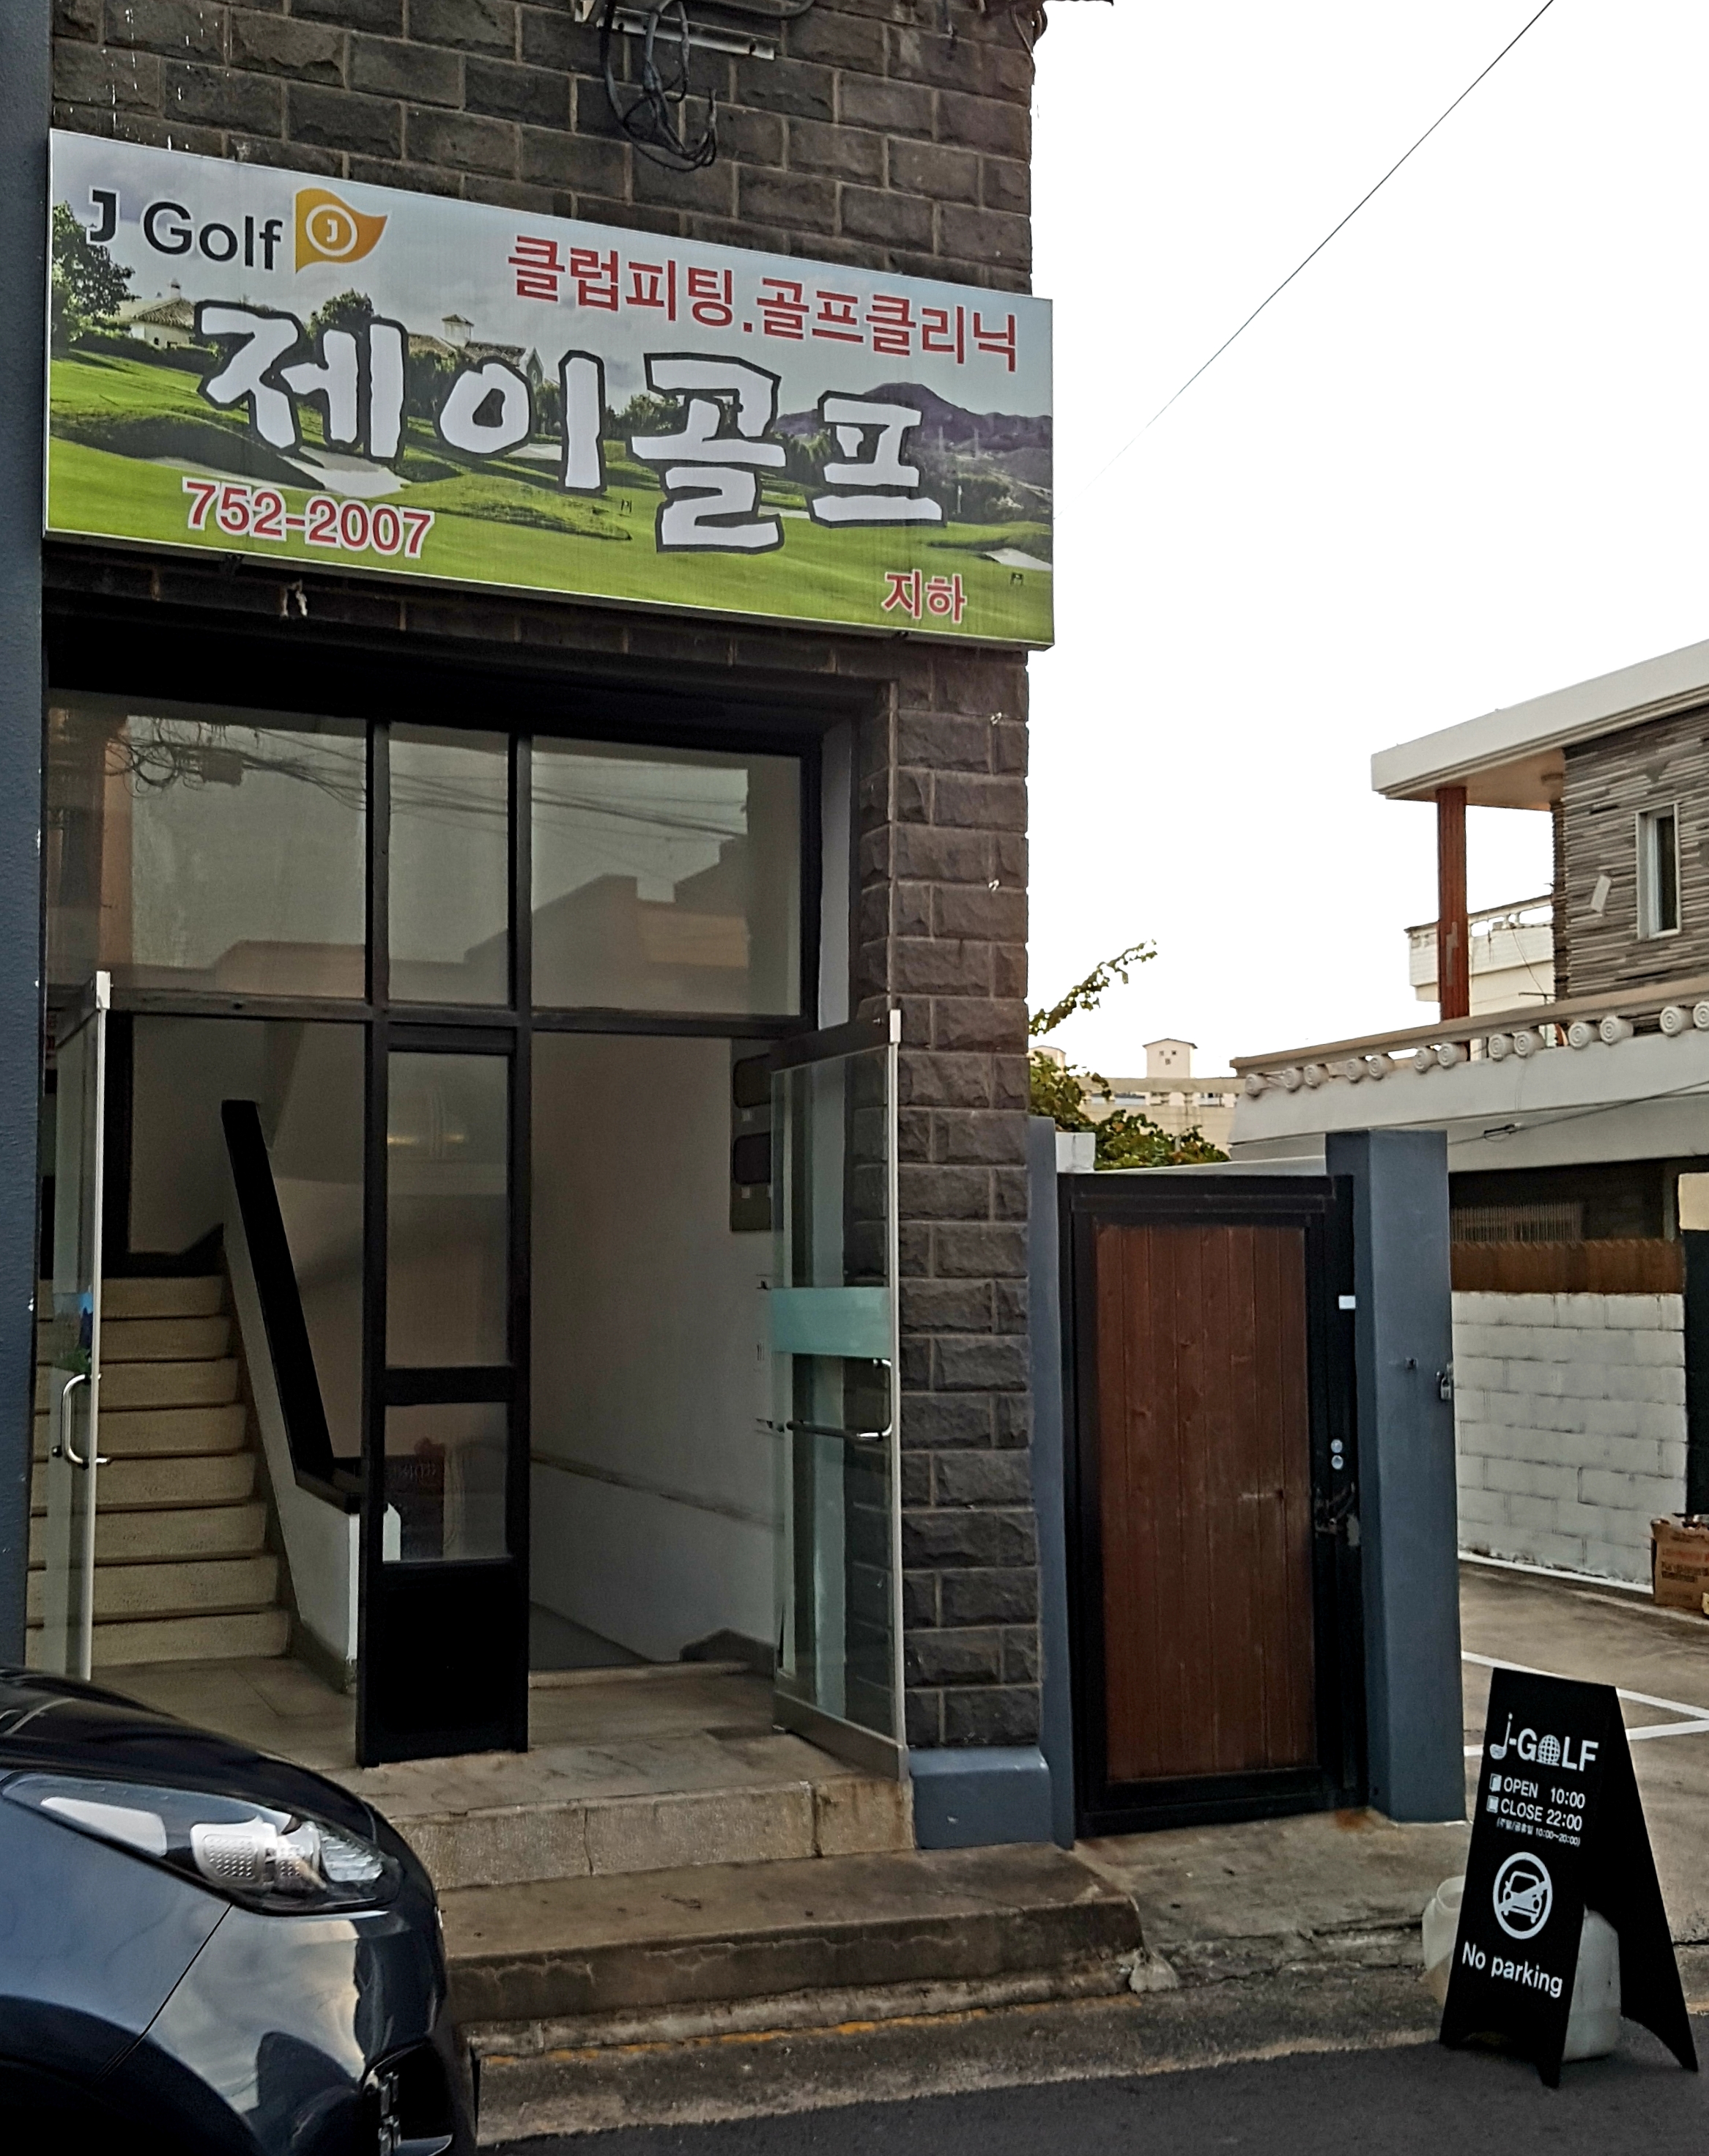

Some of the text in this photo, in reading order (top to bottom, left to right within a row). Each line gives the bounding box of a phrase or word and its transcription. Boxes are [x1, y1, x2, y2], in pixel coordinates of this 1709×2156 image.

[89, 189, 283, 270] J Golf
[508, 235, 1017, 372] 클럽피팅.골프클리닉
[196, 300, 947, 554] 제이골프
[185, 480, 432, 555] 752-2007
[883, 570, 966, 623] 지하
[1500, 1798, 1582, 1831] CLOSE 22:00
[1503, 1776, 1586, 1809] OPEN 10:00
[1462, 1941, 1563, 1998] No parking
